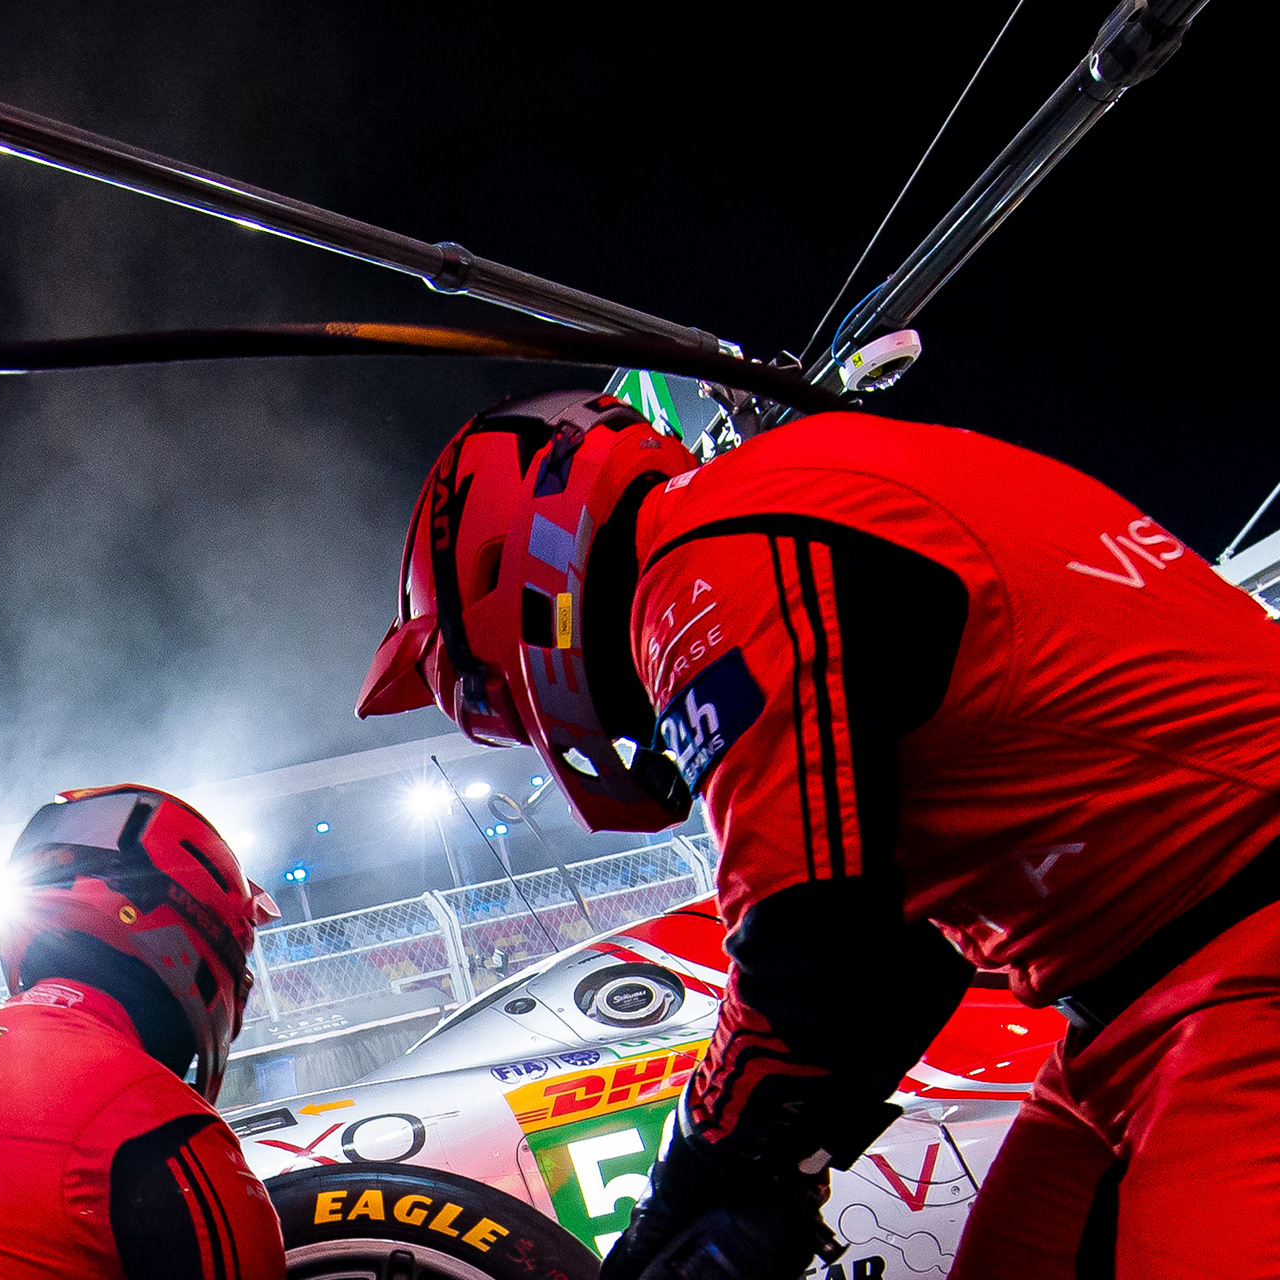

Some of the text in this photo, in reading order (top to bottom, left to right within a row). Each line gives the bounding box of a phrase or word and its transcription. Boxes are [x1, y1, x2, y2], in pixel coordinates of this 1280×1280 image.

[1066, 515, 1186, 589] VIS
[495, 1059, 546, 1082] FIA
[543, 1048, 699, 1118] DHL
[567, 1110, 677, 1260] 5
[314, 1189, 509, 1253] EAGLE
